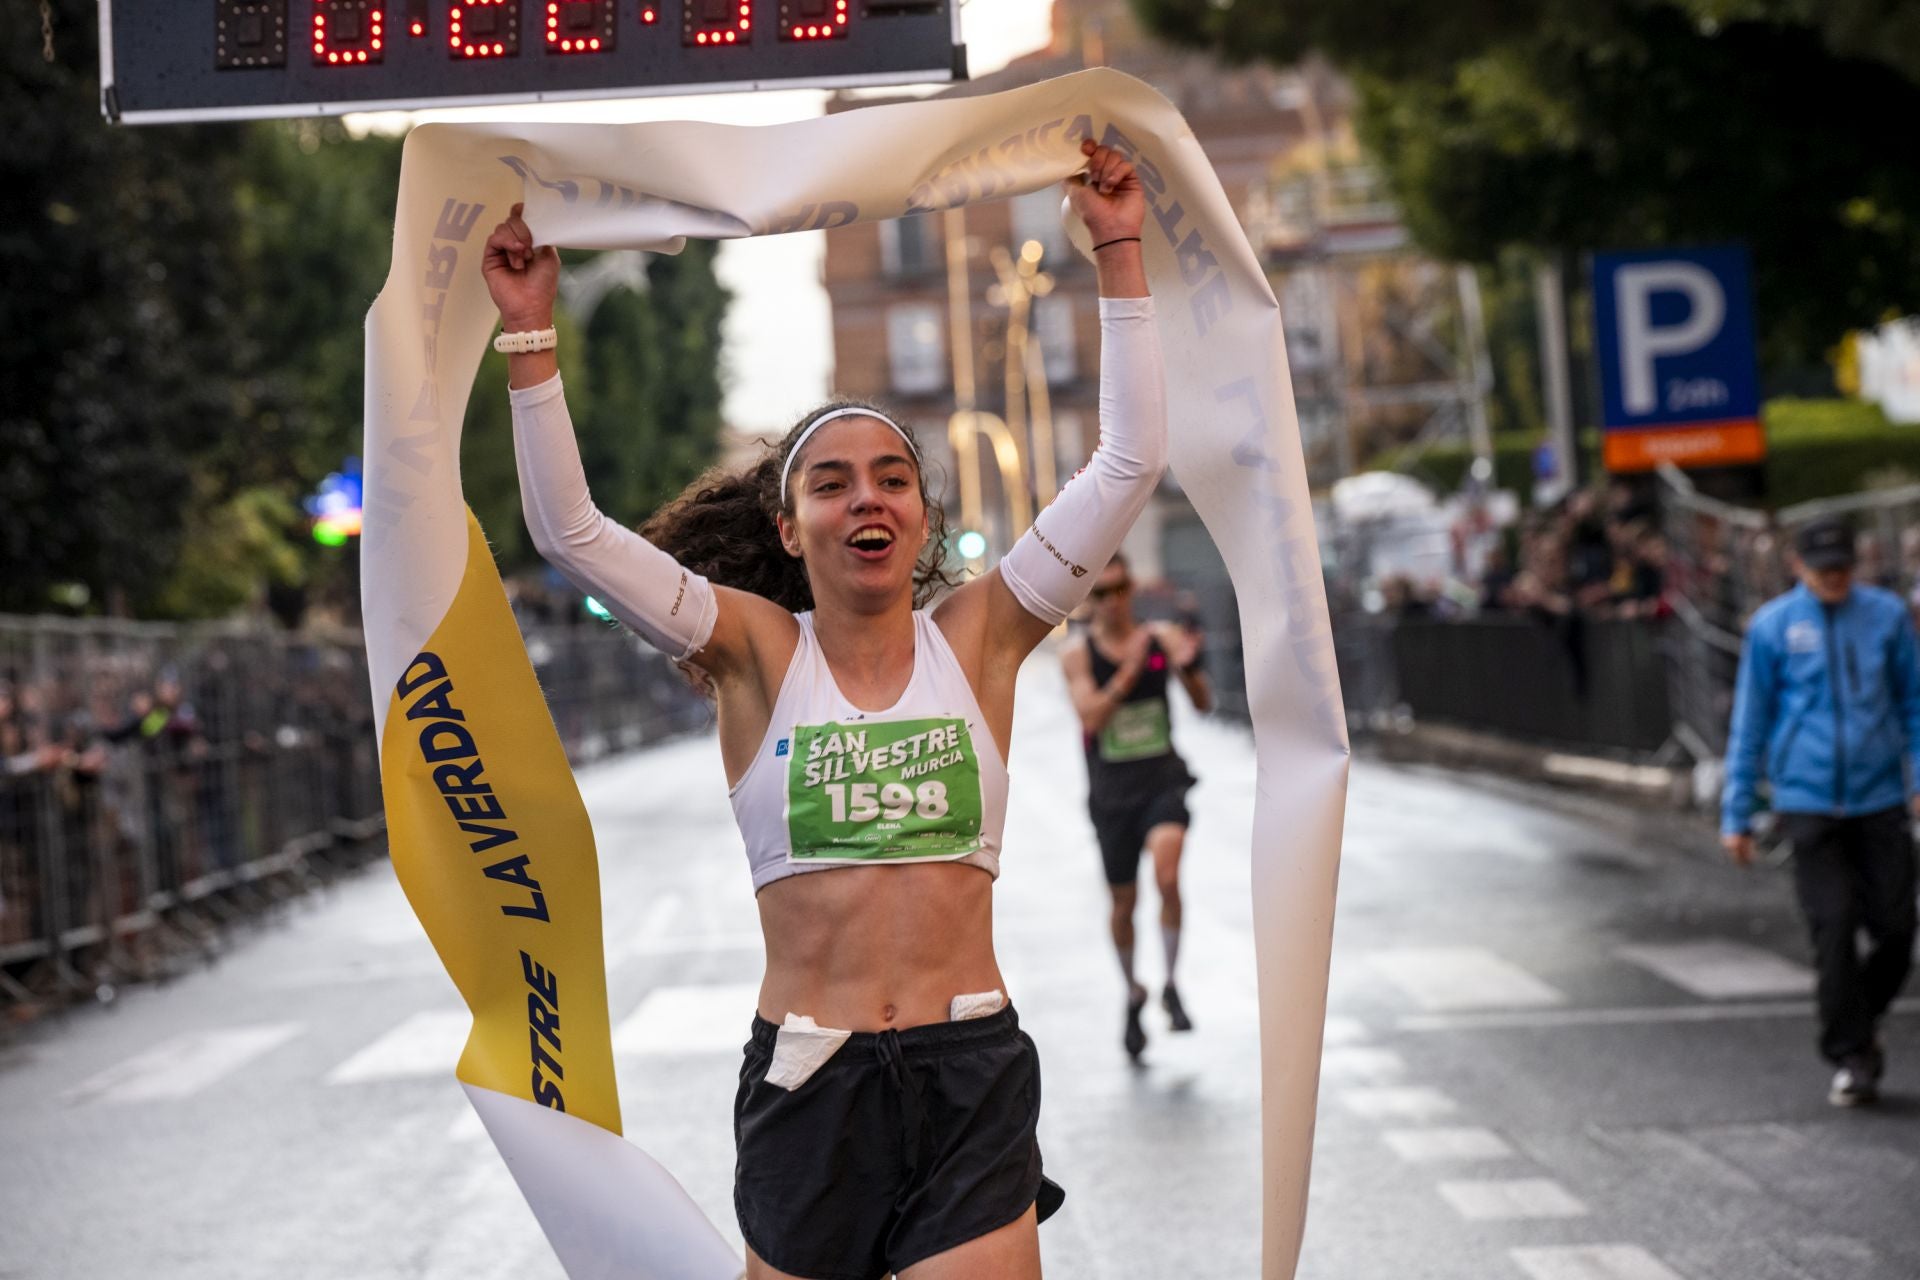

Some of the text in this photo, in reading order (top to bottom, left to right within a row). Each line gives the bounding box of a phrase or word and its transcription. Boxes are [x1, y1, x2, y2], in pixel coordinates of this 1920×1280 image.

[1614, 261, 1726, 416] P
[396, 651, 519, 854] VERDAD
[803, 724, 960, 788] SILVESTRE
[805, 730, 867, 761] SAN
[900, 750, 964, 780] MURCIA
[824, 780, 949, 823] 1598
[876, 822, 902, 830] ELENA
[482, 854, 551, 923] LA
